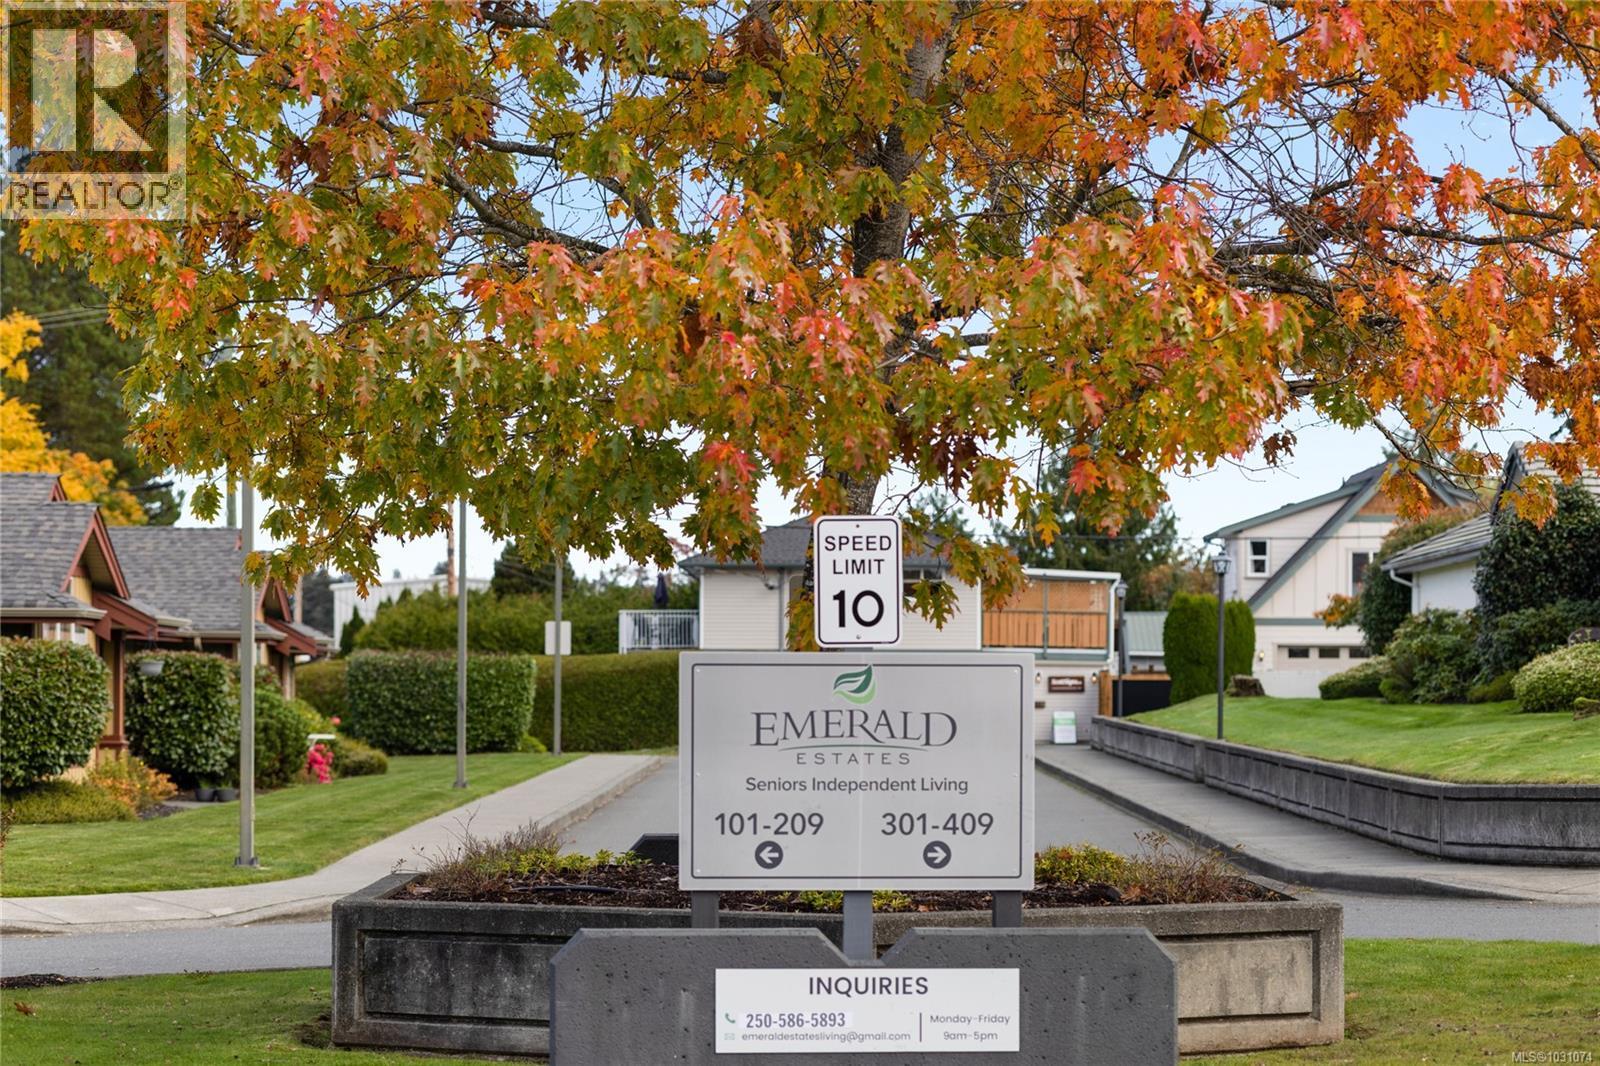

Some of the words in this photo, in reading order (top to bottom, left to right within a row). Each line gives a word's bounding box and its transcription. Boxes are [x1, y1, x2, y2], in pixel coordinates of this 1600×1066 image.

[824, 535, 892, 551] SPEED
[832, 558, 885, 575] LIMIT
[832, 589, 884, 628] 10
[750, 708, 957, 747] EMERALD
[796, 752, 910, 765] ESTATES
[745, 776, 807, 792] Seniors
[812, 776, 917, 794] Independent
[921, 776, 969, 795] Living
[714, 812, 824, 836] 101-209
[881, 812, 994, 836] 301-409
[809, 976, 929, 998] INQUIRIES
[746, 1012, 846, 1029] 250-586-5893
[741, 1031, 911, 1042] emeraldestatesliving@gmail.com
